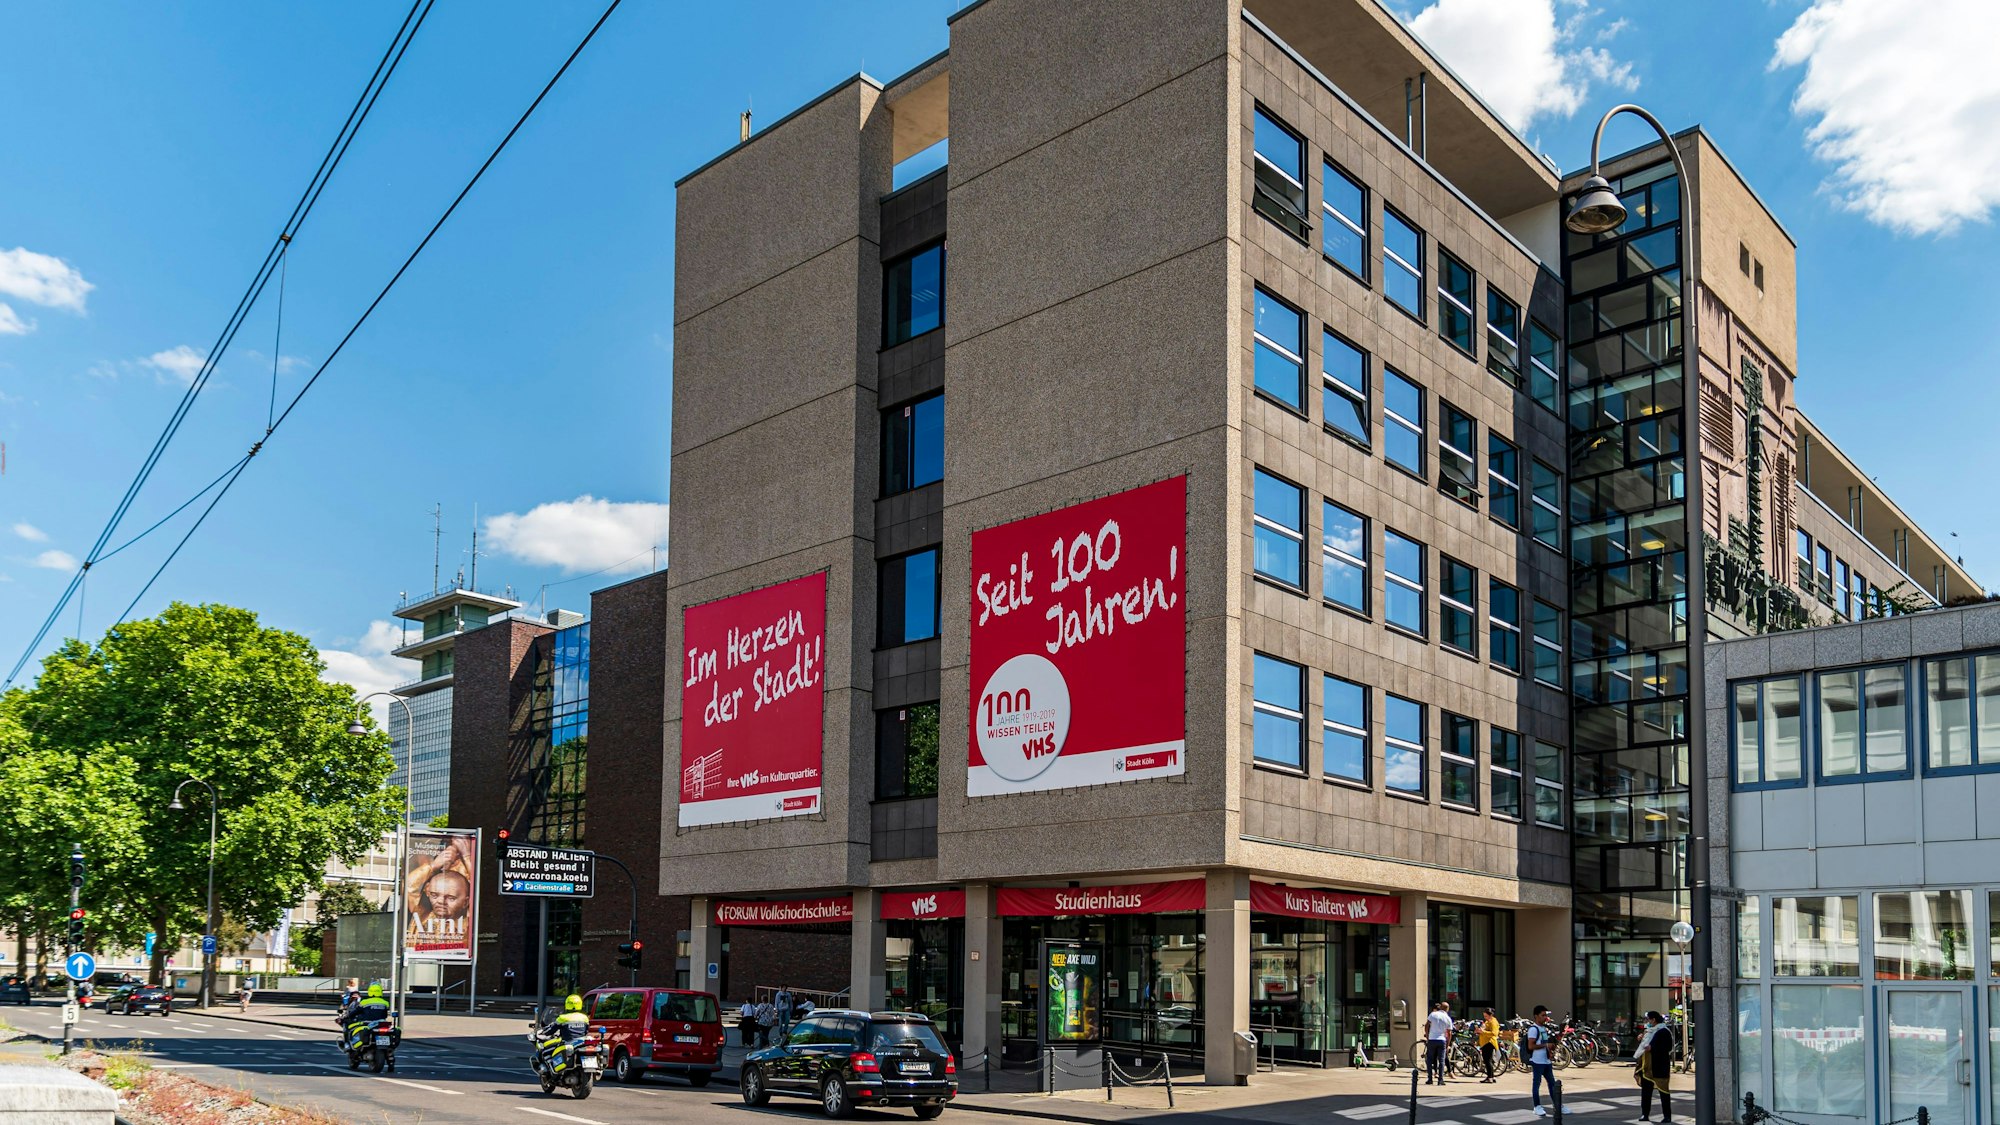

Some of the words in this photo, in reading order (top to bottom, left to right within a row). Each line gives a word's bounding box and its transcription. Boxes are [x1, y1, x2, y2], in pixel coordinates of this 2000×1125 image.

[976, 551, 1034, 627] Seit
[1050, 518, 1122, 592] 100
[1045, 545, 1178, 654] Jahren!
[686, 647, 717, 688] Im
[726, 609, 804, 670] Herzen
[704, 680, 743, 727] der
[752, 634, 821, 712] Stadt!
[995, 712, 1020, 726] JAHRE
[1022, 708, 1056, 722] 1919-2019
[987, 724, 1021, 739] WISSEN
[1023, 720, 1056, 735] TEILEN
[1021, 732, 1057, 761] VHS
[1126, 758, 1141, 768] Stadt
[1142, 756, 1155, 766] Köln
[726, 776, 739, 788] Ihre
[740, 769, 759, 789] VHS
[760, 773, 769, 784] im
[770, 767, 818, 783] Kulturquartier.
[414, 842, 446, 850] Museum
[506, 849, 548, 859] ABSTAND
[510, 860, 539, 869] Bleibt
[544, 863, 577, 872] gesund
[504, 872, 589, 882] www.corona.koeln
[912, 894, 938, 916] VHS
[1054, 890, 1142, 910] Studienhaus
[1285, 892, 1310, 912] Kurs
[1312, 894, 1346, 916] halten:
[1347, 898, 1368, 919] VHS
[724, 906, 758, 920] FORUM
[760, 901, 840, 920] Volkshochschule
[406, 911, 465, 934] Arnt
[1052, 954, 1066, 964] NEU:
[1067, 954, 1080, 964] AXE
[1080, 955, 1096, 964] WILD
[67, 1008, 74, 1020] 5
